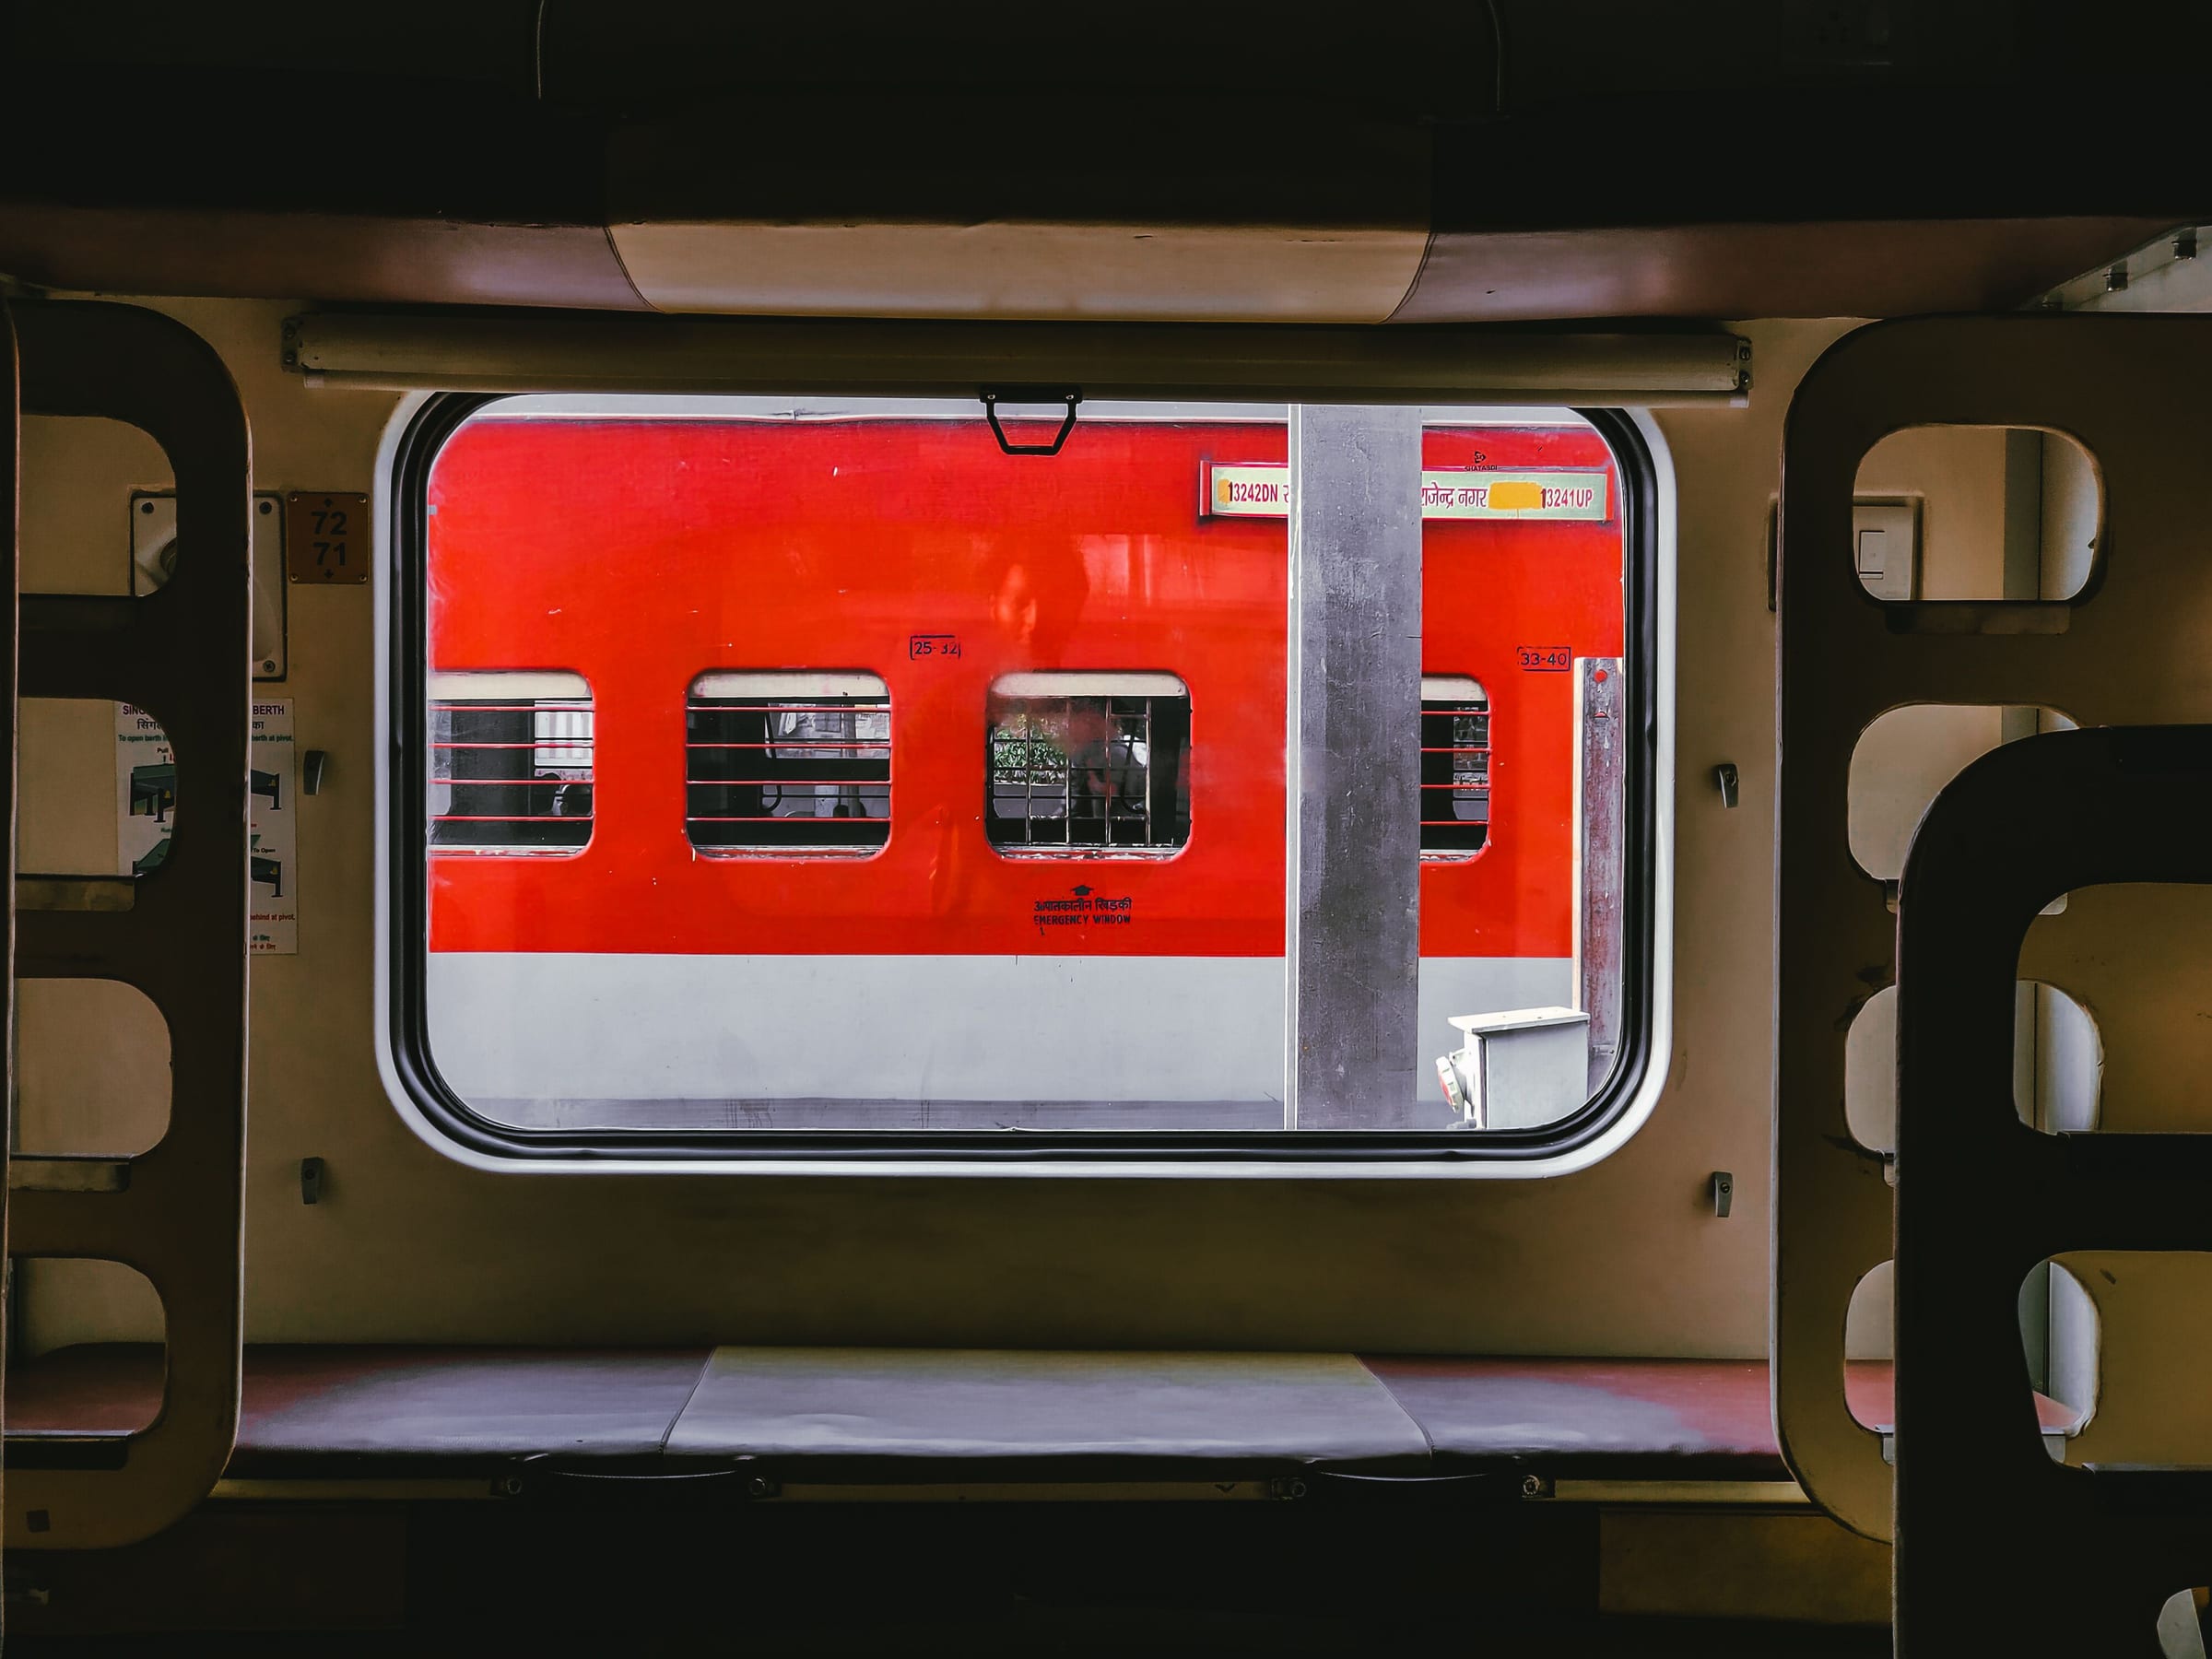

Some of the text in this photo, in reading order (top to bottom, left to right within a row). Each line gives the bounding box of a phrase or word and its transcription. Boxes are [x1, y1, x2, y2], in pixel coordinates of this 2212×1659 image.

[1228, 481, 1278, 502] 13242DN
[1457, 488, 1488, 507] नगर
[1540, 488, 1593, 509] 13241UP
[311, 511, 347, 535] 72
[312, 542, 347, 566] 71
[1520, 653, 1567, 665] 33-40
[253, 705, 285, 715] BERTH
[1033, 914, 1131, 925] EMERGENCY WINDOW
